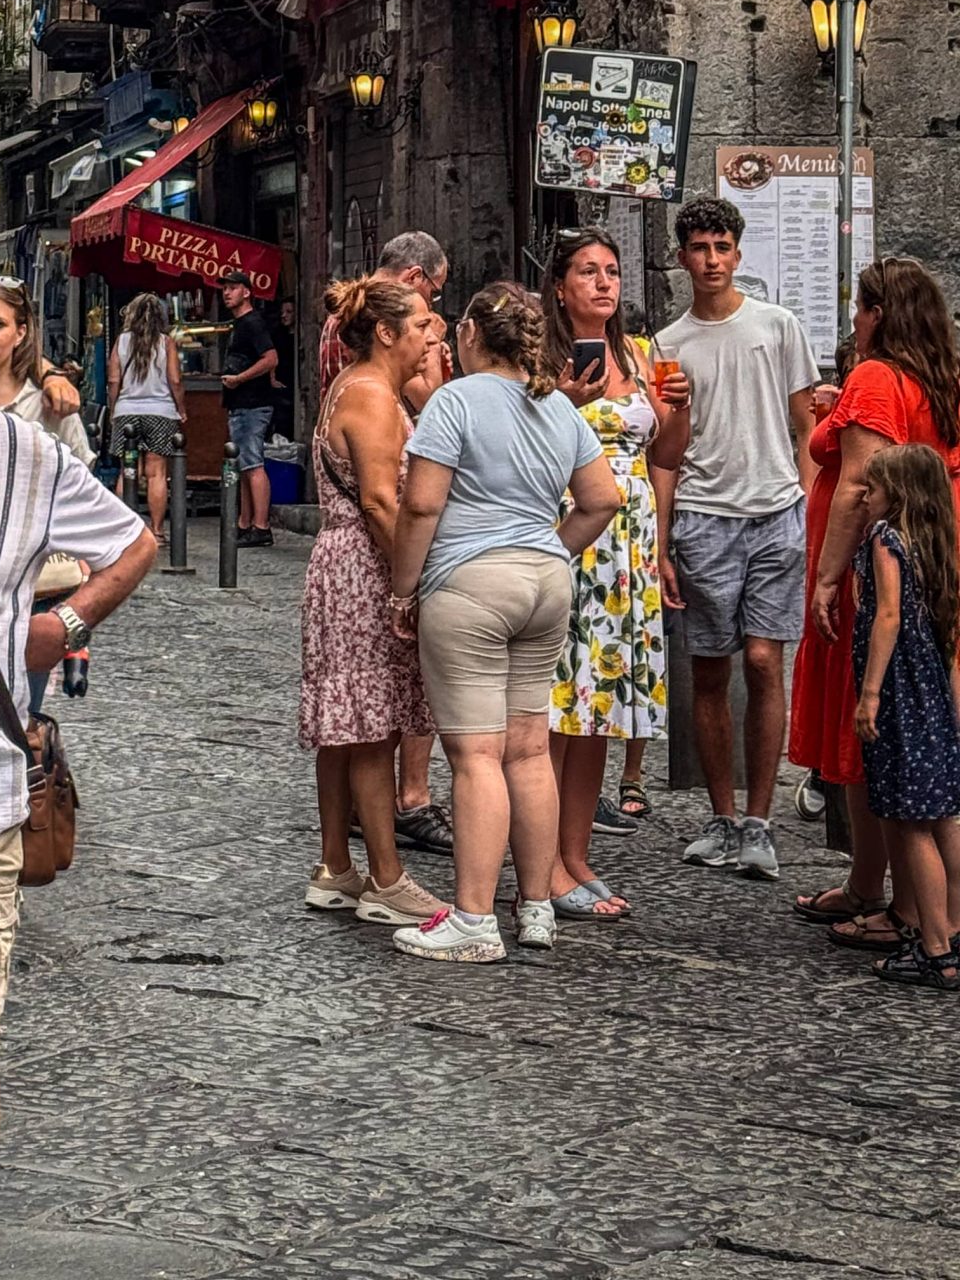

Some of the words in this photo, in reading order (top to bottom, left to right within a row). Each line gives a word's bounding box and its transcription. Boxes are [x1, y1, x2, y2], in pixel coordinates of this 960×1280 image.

[545, 96, 588, 113] Napoli
[778, 153, 836, 173] Menù
[159, 227, 219, 259] PIZZA
[228, 249, 242, 265] A
